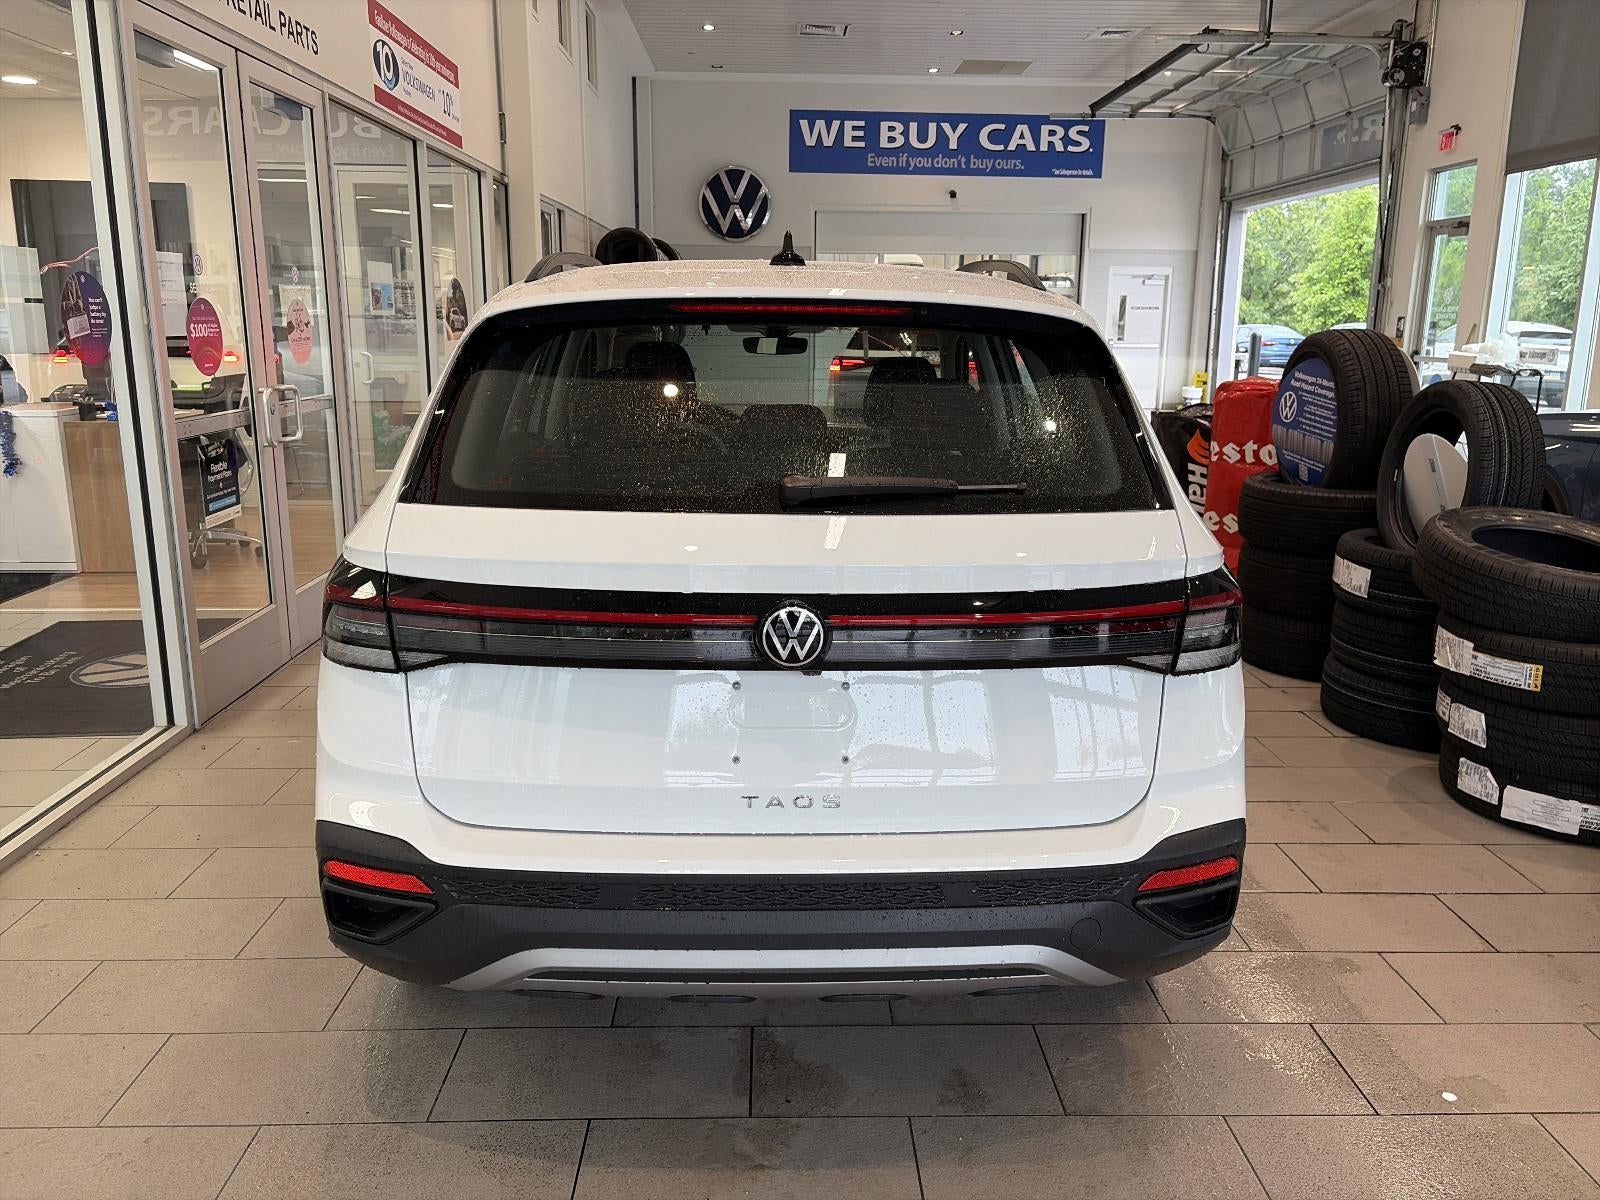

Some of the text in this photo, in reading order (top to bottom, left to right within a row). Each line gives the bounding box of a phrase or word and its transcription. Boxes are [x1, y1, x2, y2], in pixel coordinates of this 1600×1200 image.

[278, 9, 319, 55] PARTS
[376, 40, 393, 81] 10
[402, 67, 436, 103] VOLKSWAGEN
[799, 119, 866, 147] WE
[880, 120, 968, 150] BUY
[867, 153, 1025, 172] Even if you don't buy ours.
[190, 323, 208, 339] $100
[1294, 370, 1316, 384] Volkswagen
[1290, 379, 1336, 398] Road Hazard Coverage
[741, 794, 841, 809] TAOS
